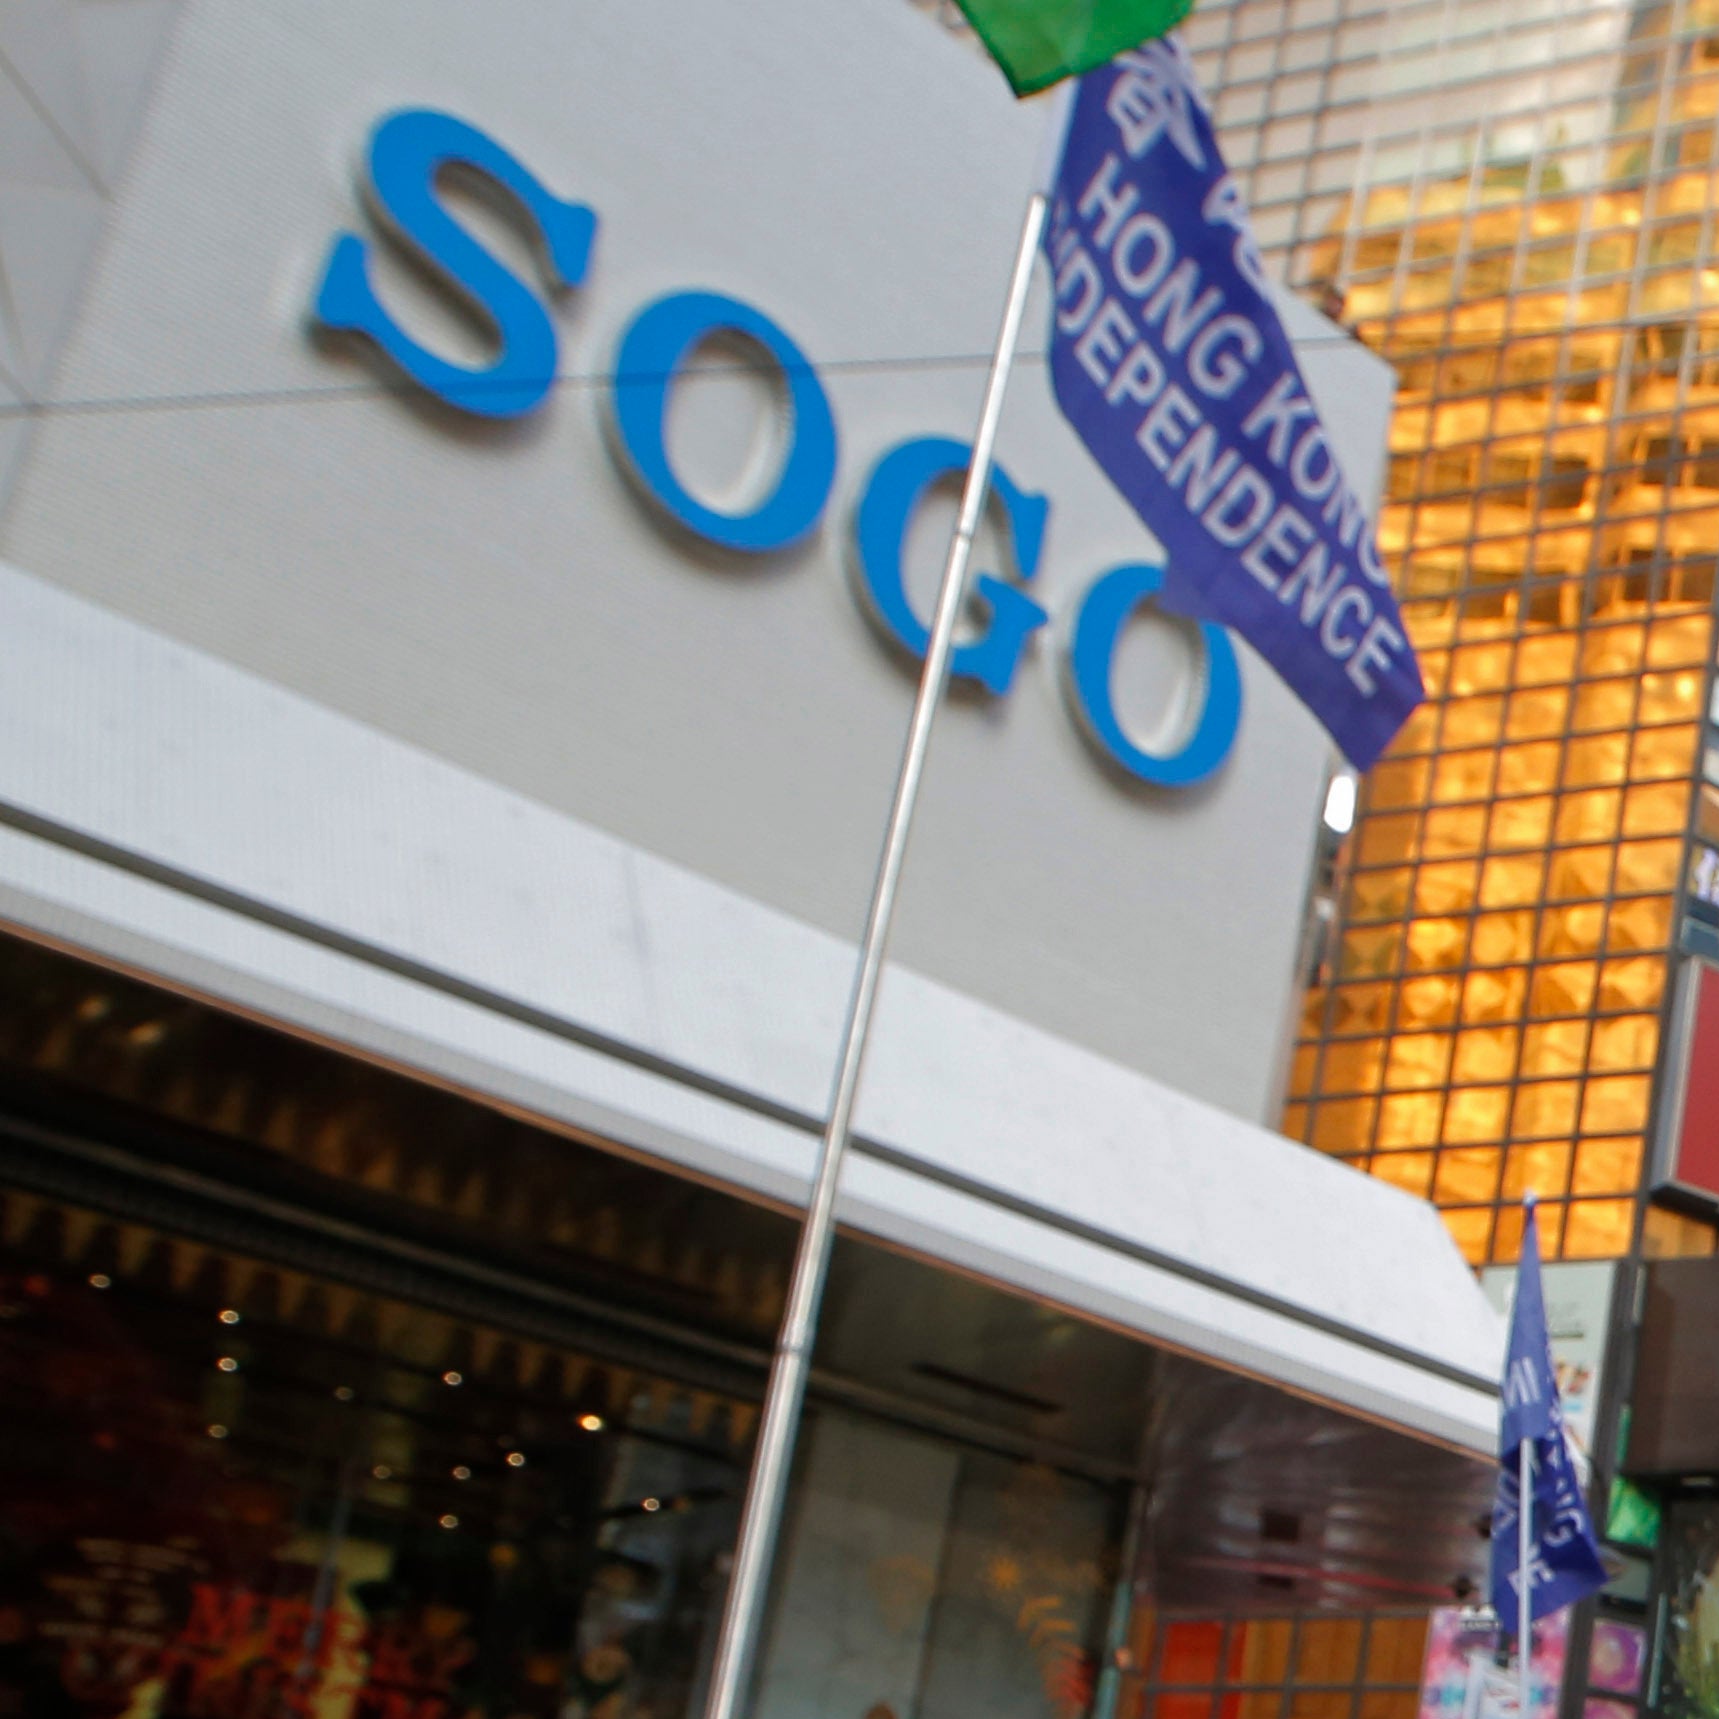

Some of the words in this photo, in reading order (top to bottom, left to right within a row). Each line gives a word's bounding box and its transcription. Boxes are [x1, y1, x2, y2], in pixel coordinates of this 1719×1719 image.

[314, 106, 1243, 788] SOGO
[1054, 225, 1405, 698] DEPENDENCE
[1078, 151, 1264, 399] HONG
